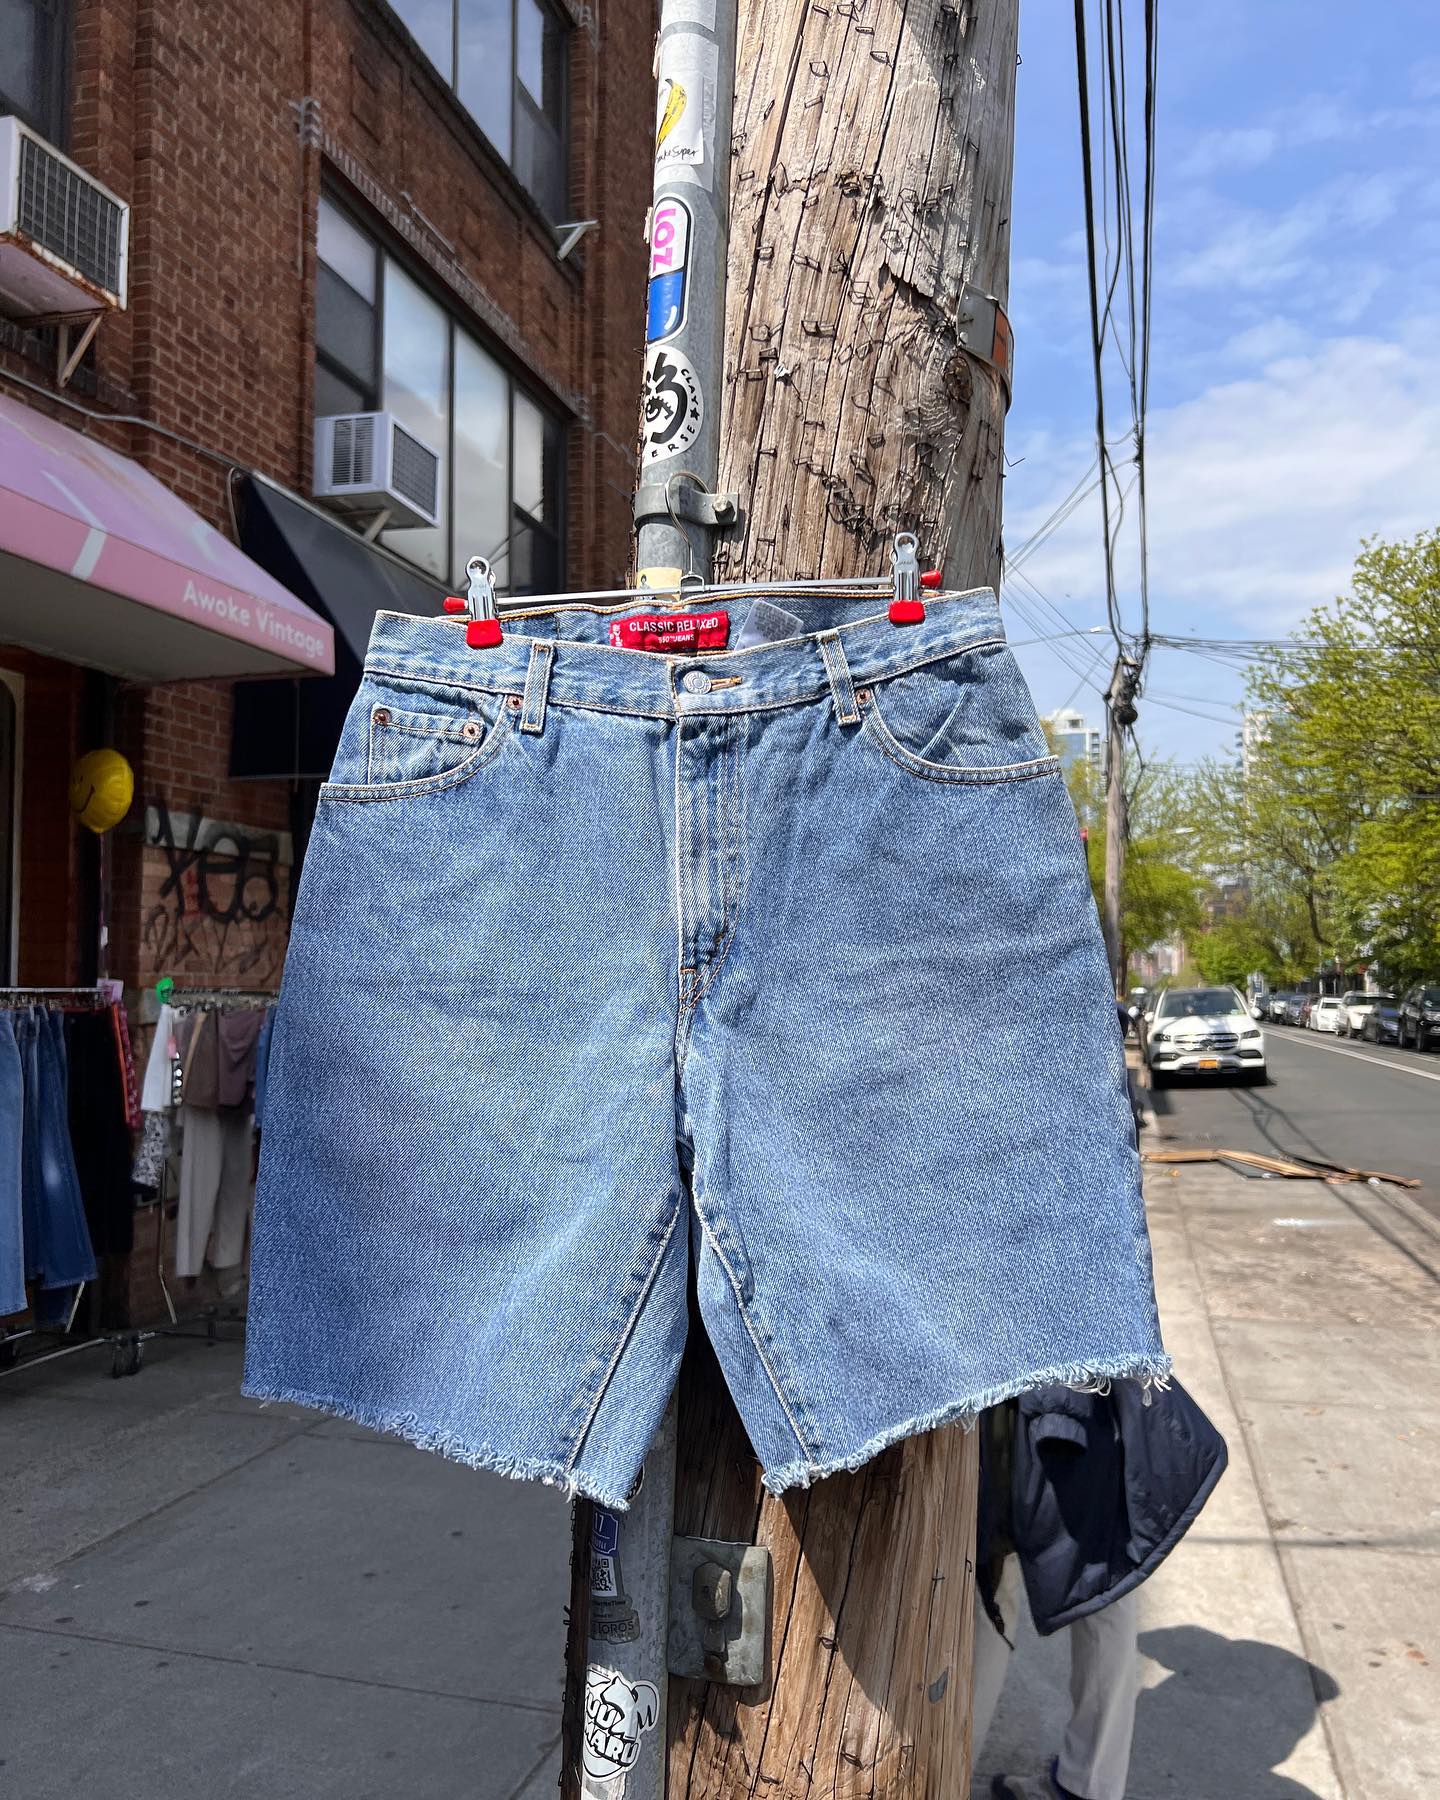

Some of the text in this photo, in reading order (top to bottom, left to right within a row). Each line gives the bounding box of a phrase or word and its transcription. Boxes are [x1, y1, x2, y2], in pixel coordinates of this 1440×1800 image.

[681, 369, 699, 405] CLAY
[184, 580, 324, 658] Awoke Vintage
[629, 621, 675, 632] CLASSIC
